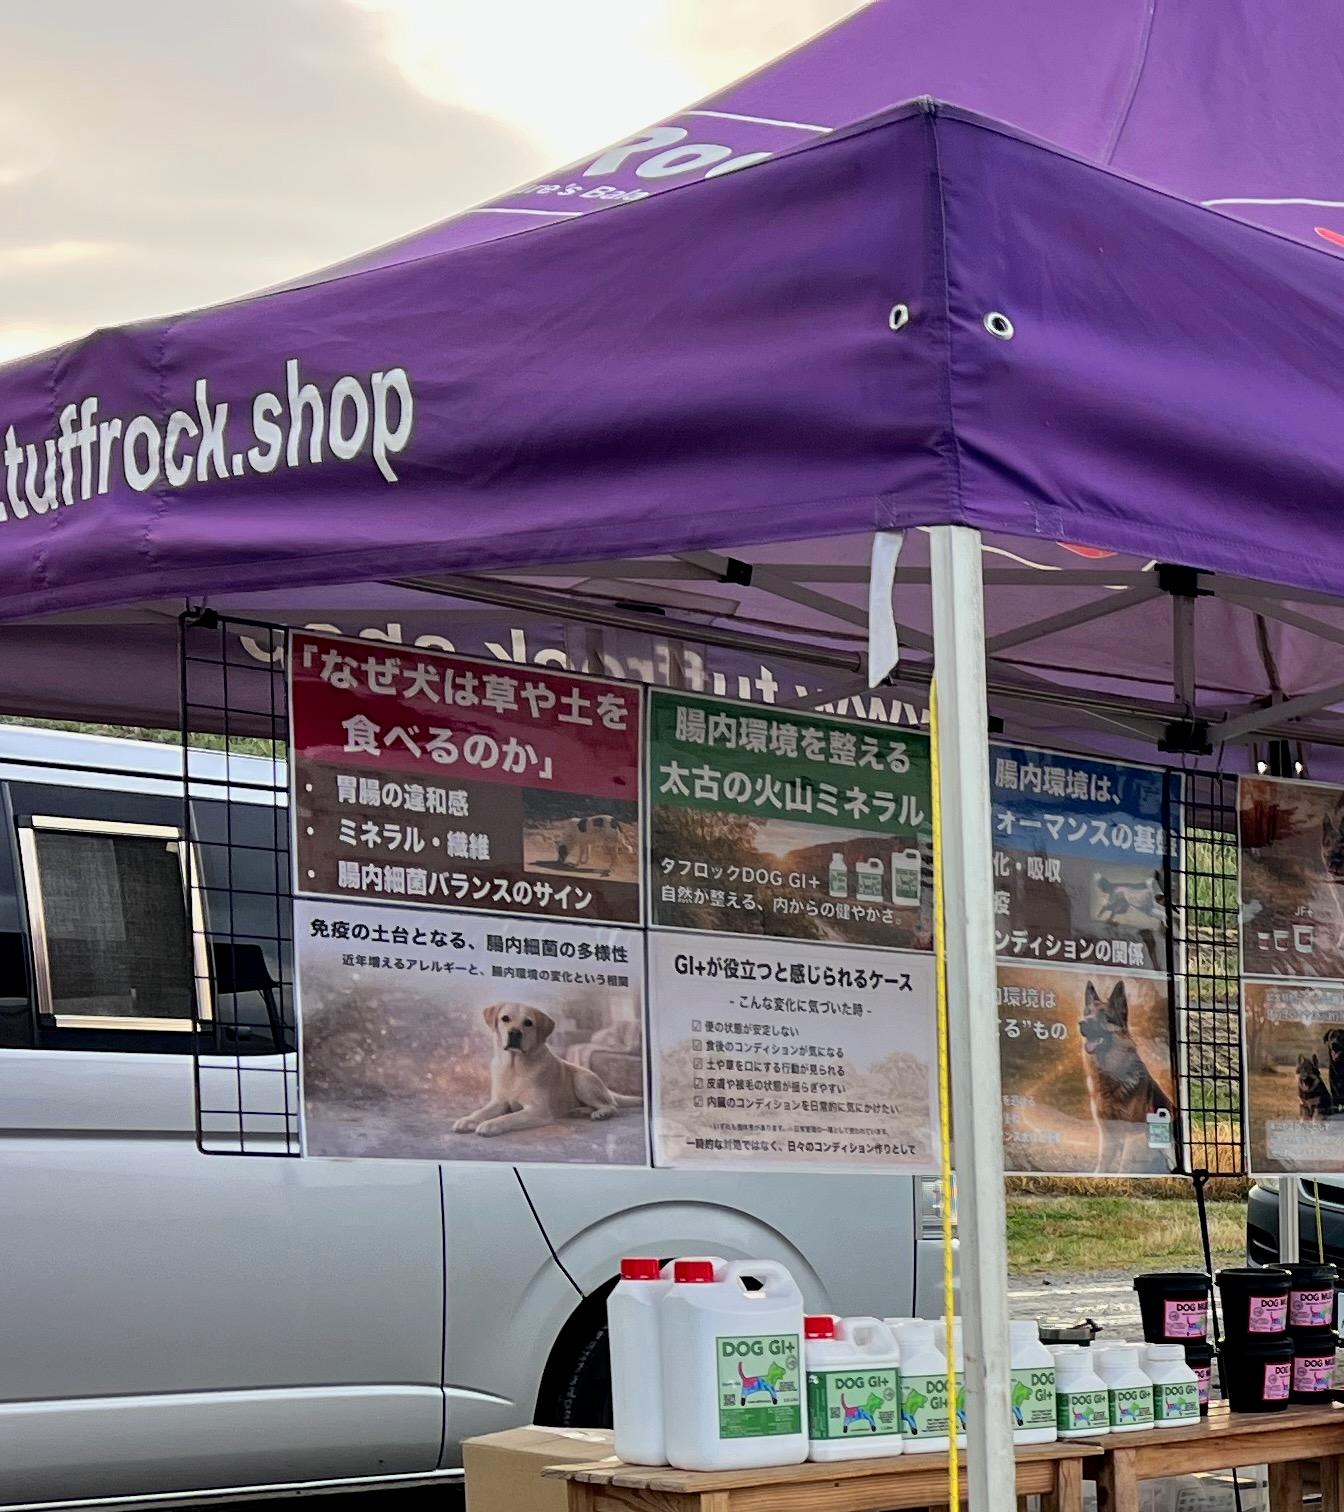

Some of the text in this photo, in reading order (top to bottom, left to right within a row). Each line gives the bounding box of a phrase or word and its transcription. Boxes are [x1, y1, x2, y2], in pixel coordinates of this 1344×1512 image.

[303, 645, 629, 731] 「なぜ犬は草や土を
[341, 714, 553, 780] 食べるのか」
[675, 705, 911, 774] 腸内環境を整える
[336, 775, 470, 817] 胃腸の違和感
[659, 760, 925, 827] 太古の火山ミネラル
[995, 758, 1120, 805] 腸内環境は、
[338, 819, 491, 861] ミネラル・繊維
[993, 851, 1061, 884] 化・吸収
[337, 861, 592, 911] 腸内細菌バランスのサイン
[310, 918, 629, 964] 免疫の土台となる、腸内細菌の多様性
[995, 929, 1144, 966] ンディションの関係
[674, 954, 913, 992] GI+が役立つと感じられるケース
[1176, 1303, 1196, 1312] DOG
[1261, 1300, 1279, 1308] DOG
[1300, 1293, 1319, 1302] DOG
[722, 1340, 795, 1357] DOG GI+
[1304, 1360, 1323, 1368] DOG
[836, 1375, 889, 1390] DOG GI+
[1031, 1372, 1055, 1386] DOG
[1035, 1389, 1052, 1402] GI+
[1117, 1389, 1152, 1401] DOG GI+
[1164, 1384, 1197, 1396] DOG GI+
[1071, 1393, 1106, 1406] DOG GI+
